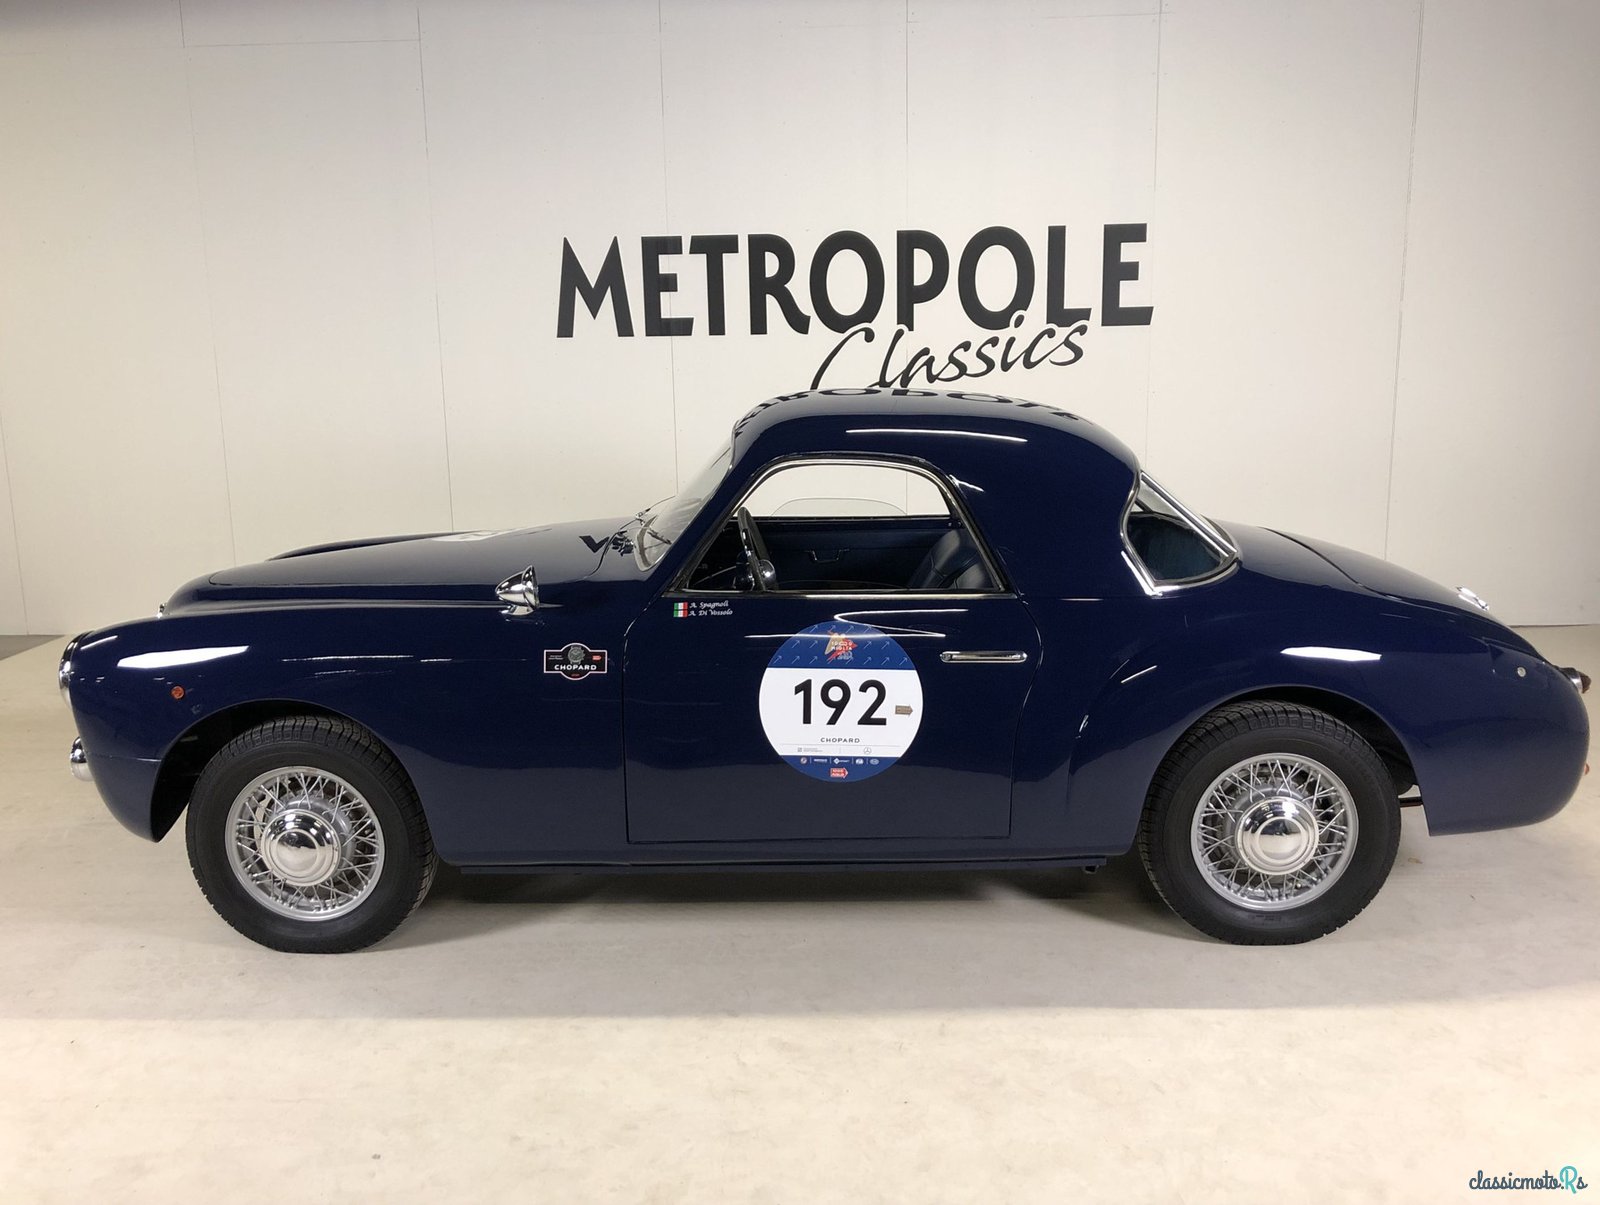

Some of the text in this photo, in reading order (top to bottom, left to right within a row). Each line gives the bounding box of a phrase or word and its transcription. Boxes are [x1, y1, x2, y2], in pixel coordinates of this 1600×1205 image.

[556, 223, 1154, 338] METROPOLE
[810, 310, 1088, 390] Classics
[794, 679, 887, 726] 192
